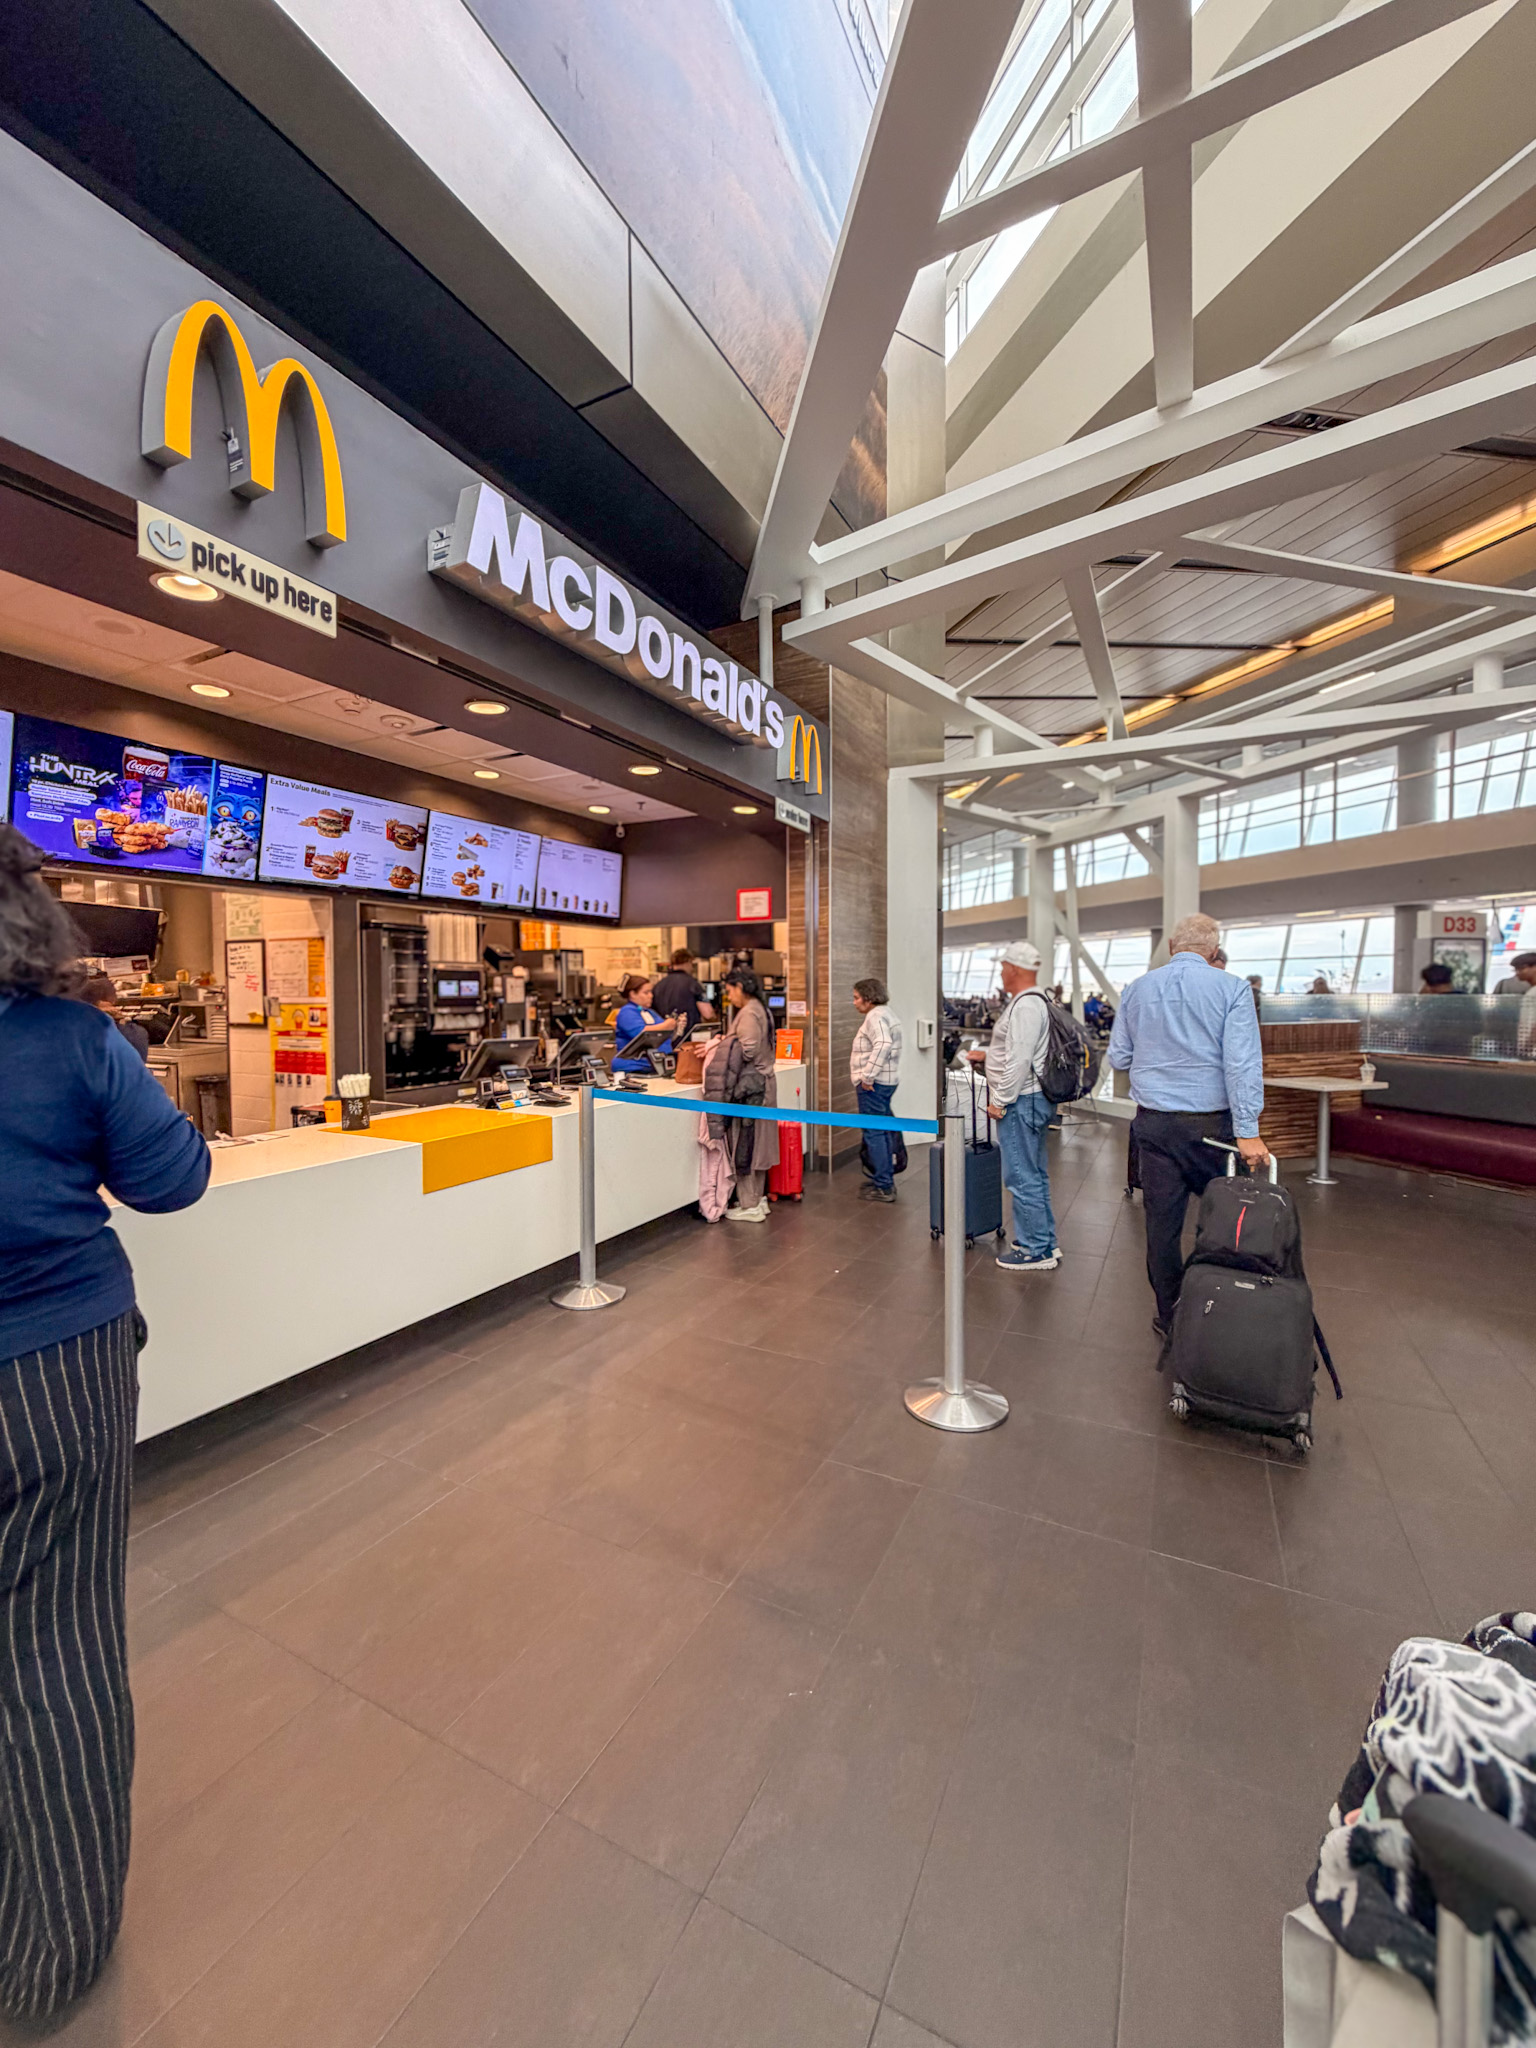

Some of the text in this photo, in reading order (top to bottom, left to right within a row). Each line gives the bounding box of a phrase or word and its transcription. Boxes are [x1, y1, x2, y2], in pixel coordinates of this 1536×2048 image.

[191, 542, 333, 623] pick up here
[467, 482, 785, 749] McDonald's
[270, 777, 331, 797] Extra Value Meals
[1443, 916, 1476, 933] D33
